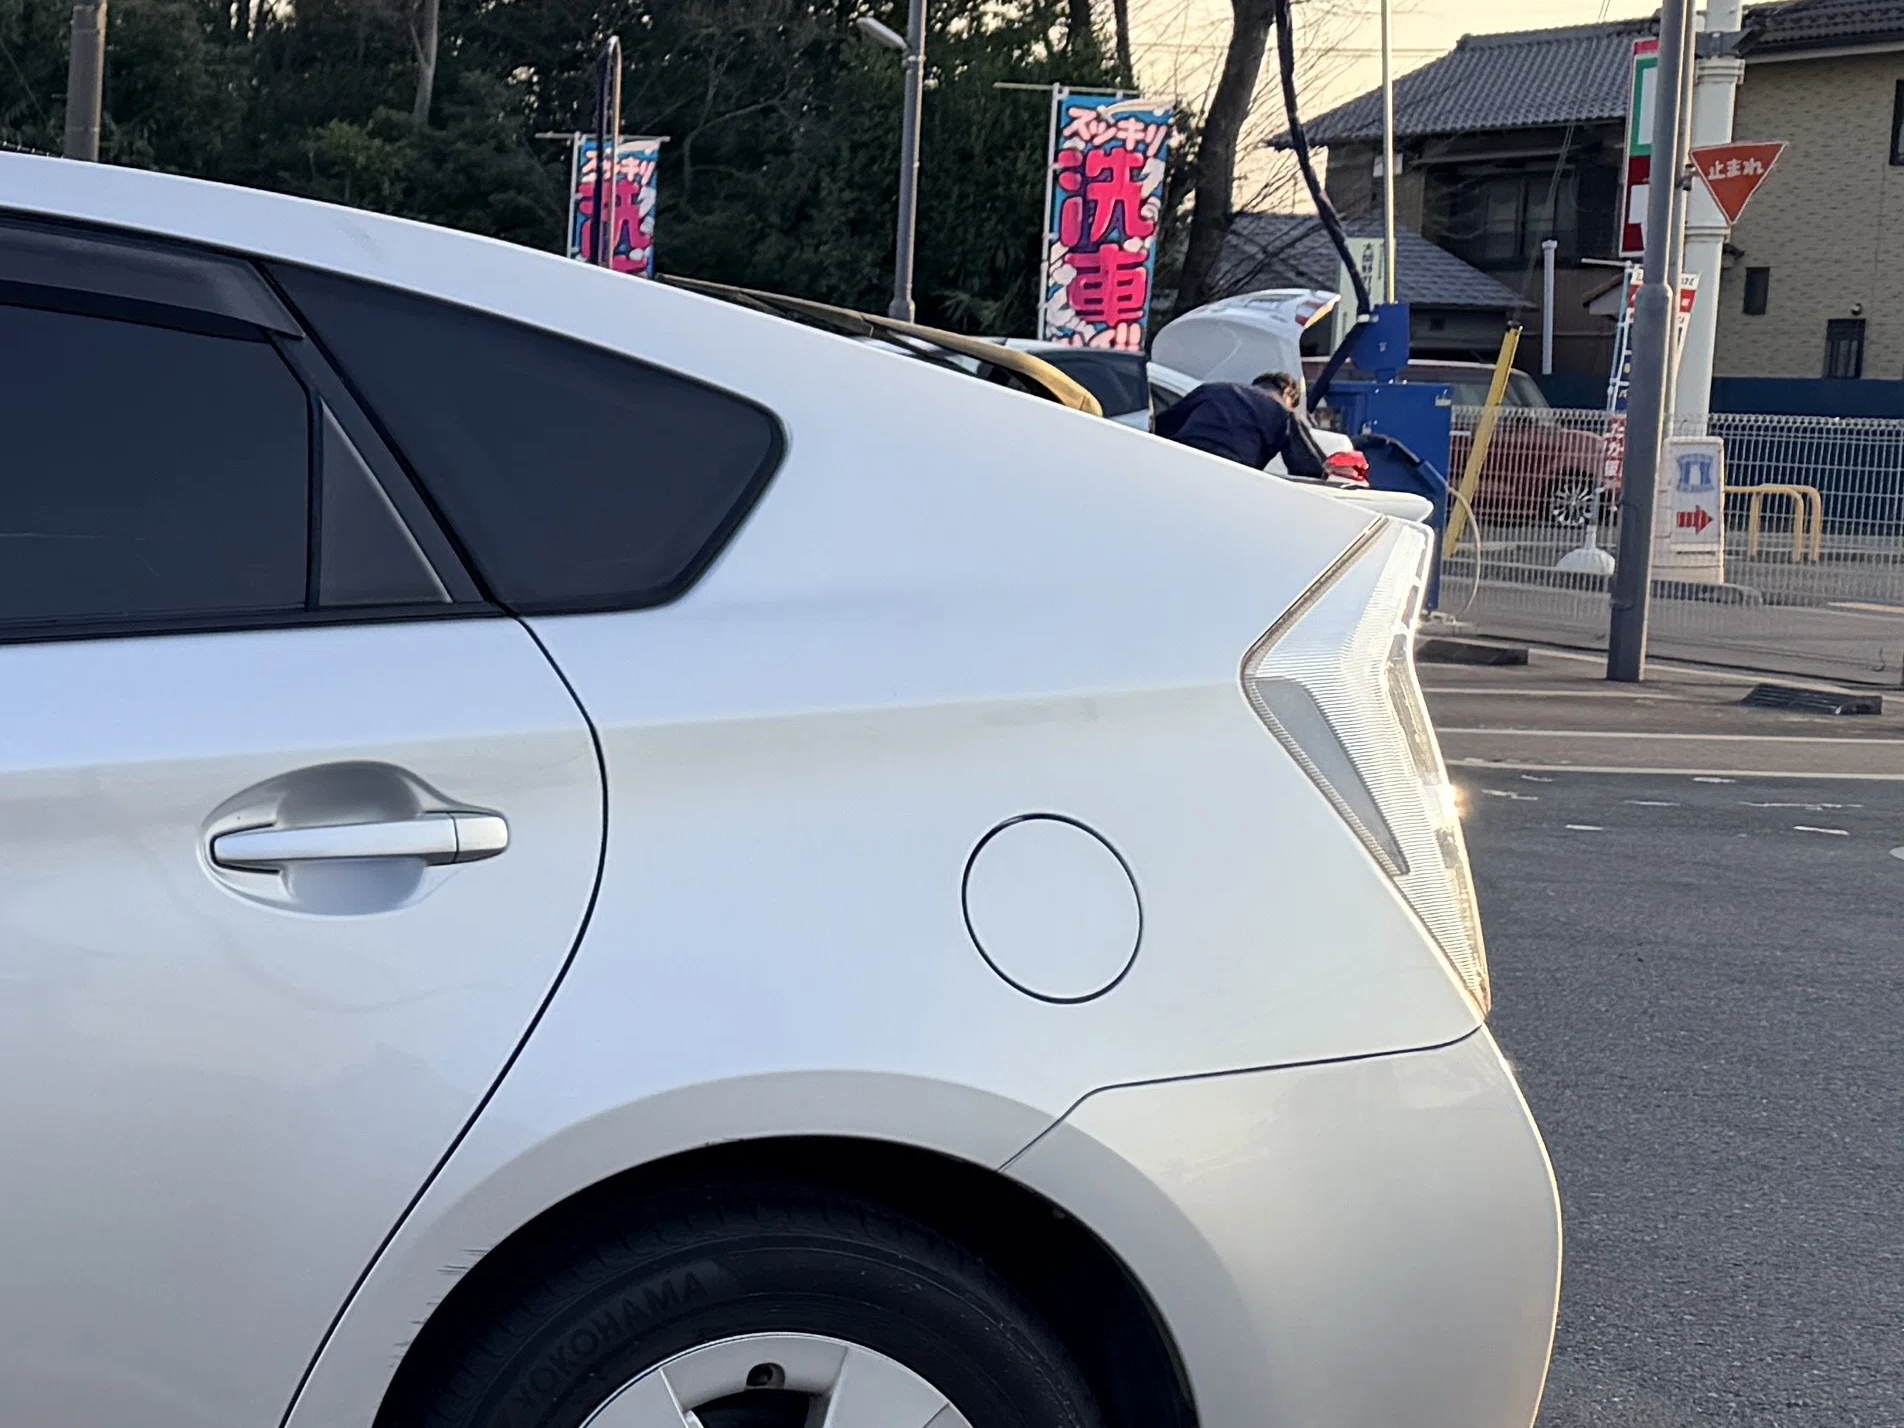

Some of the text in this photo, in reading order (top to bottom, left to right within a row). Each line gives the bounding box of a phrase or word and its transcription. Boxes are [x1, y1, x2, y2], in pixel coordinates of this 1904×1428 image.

[1063, 107, 1168, 157] スッキリ
[1708, 157, 1764, 180] 止まれ
[1057, 147, 1155, 326] 洗車
[510, 1272, 710, 1408] YOKOHAMA
